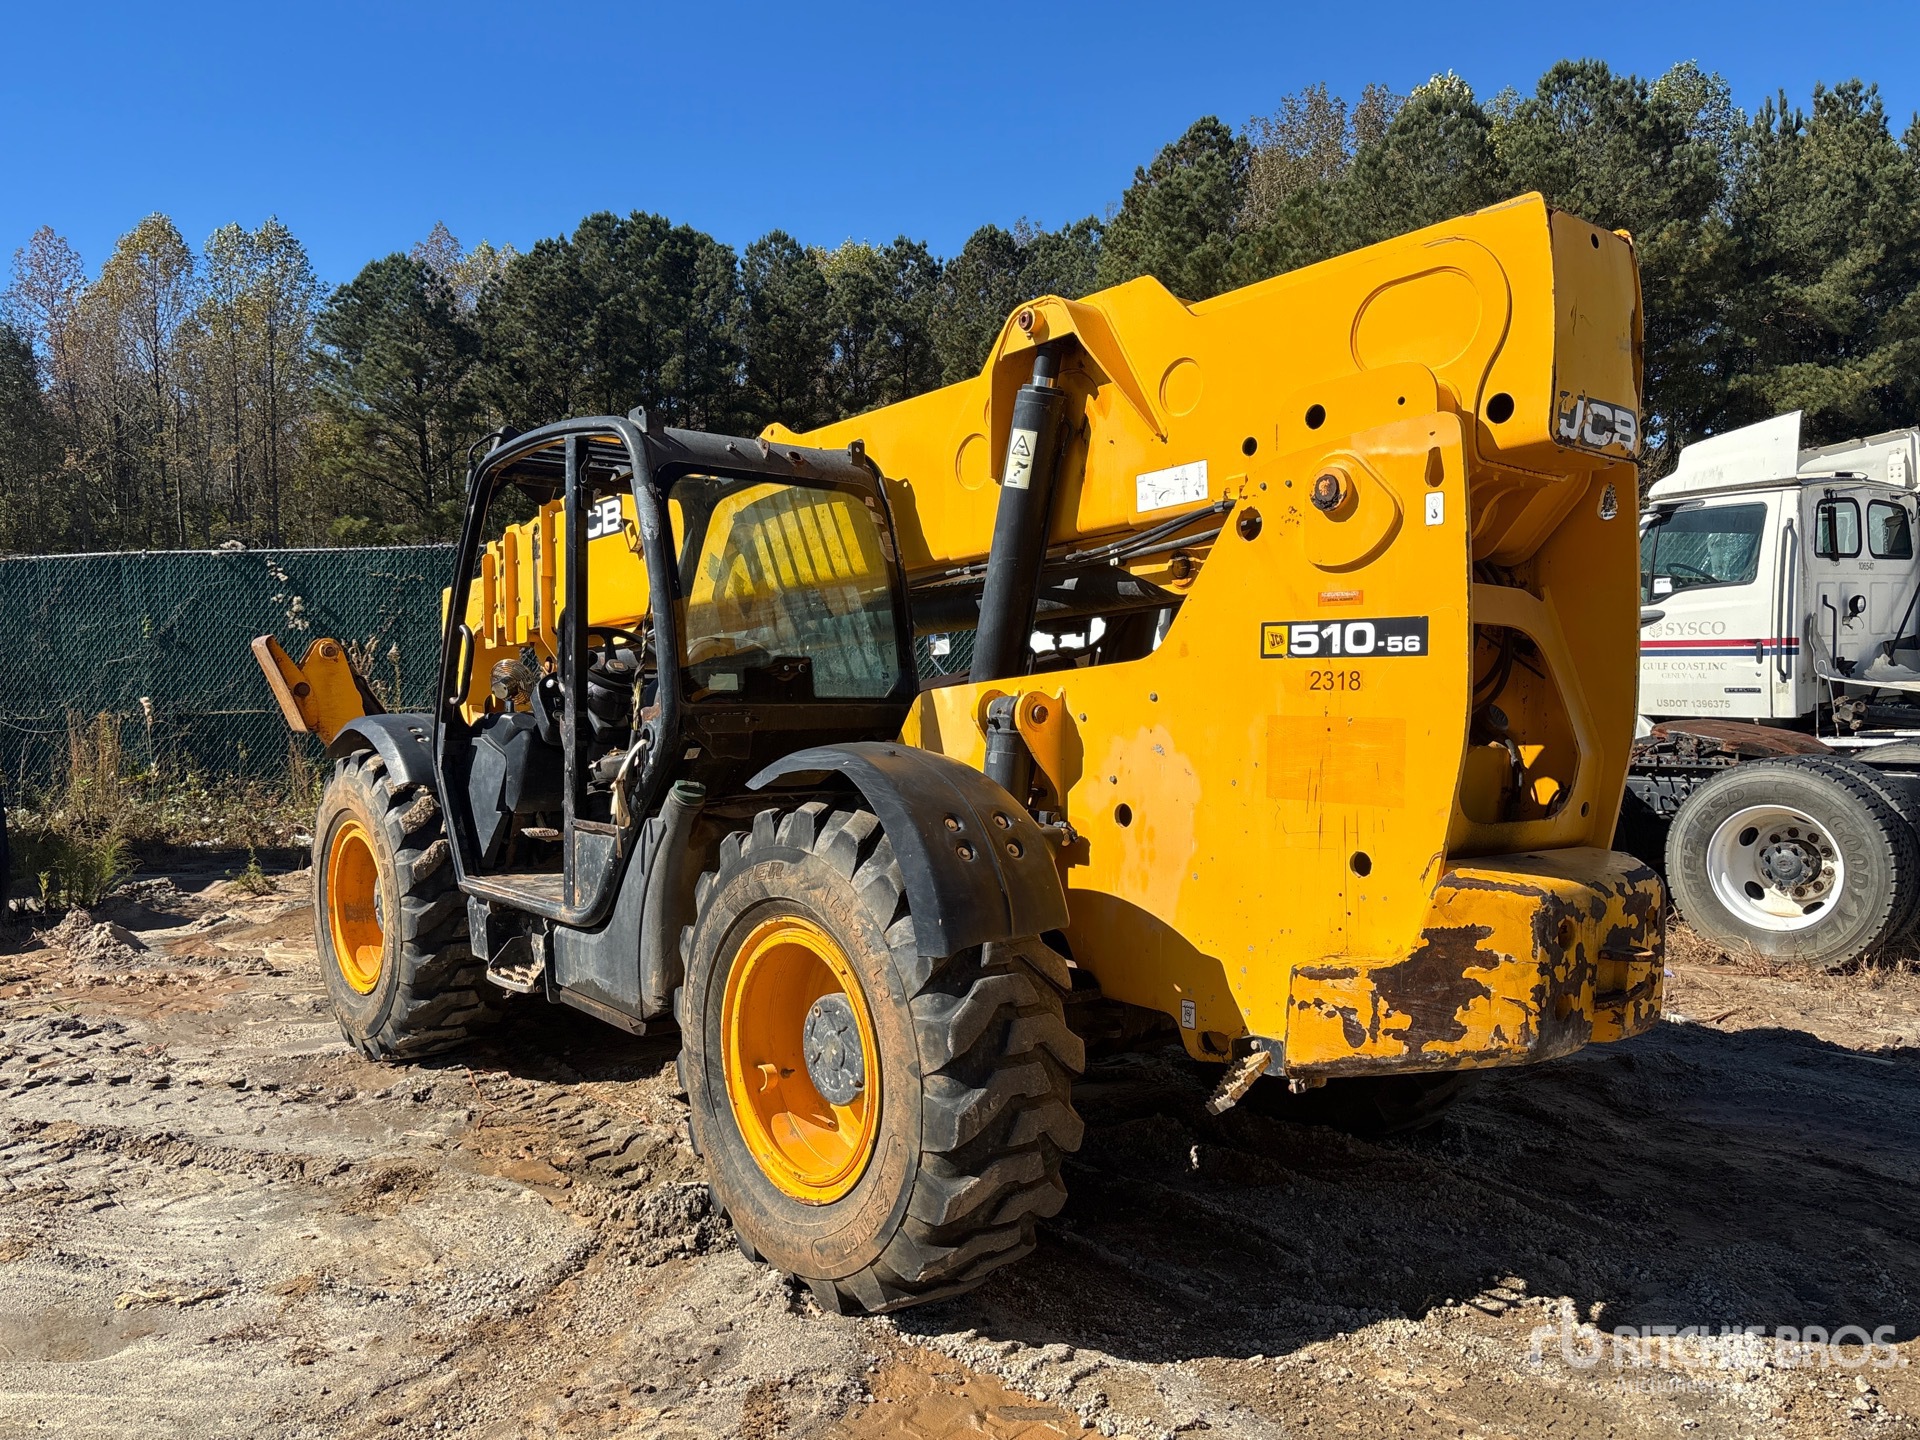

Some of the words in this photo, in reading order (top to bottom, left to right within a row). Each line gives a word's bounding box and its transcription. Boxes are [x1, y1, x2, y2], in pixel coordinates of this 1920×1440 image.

[1559, 399, 1637, 450] JCB
[588, 499, 622, 540] CB
[1665, 621, 1726, 636] SYSCO
[1268, 632, 1285, 647] JCB
[1643, 662, 1668, 671] GULF
[1309, 670, 1362, 691] 2318
[1656, 699, 1688, 708] USDOT
[1691, 700, 1731, 709] 1396375
[1696, 788, 1745, 829] RSD
